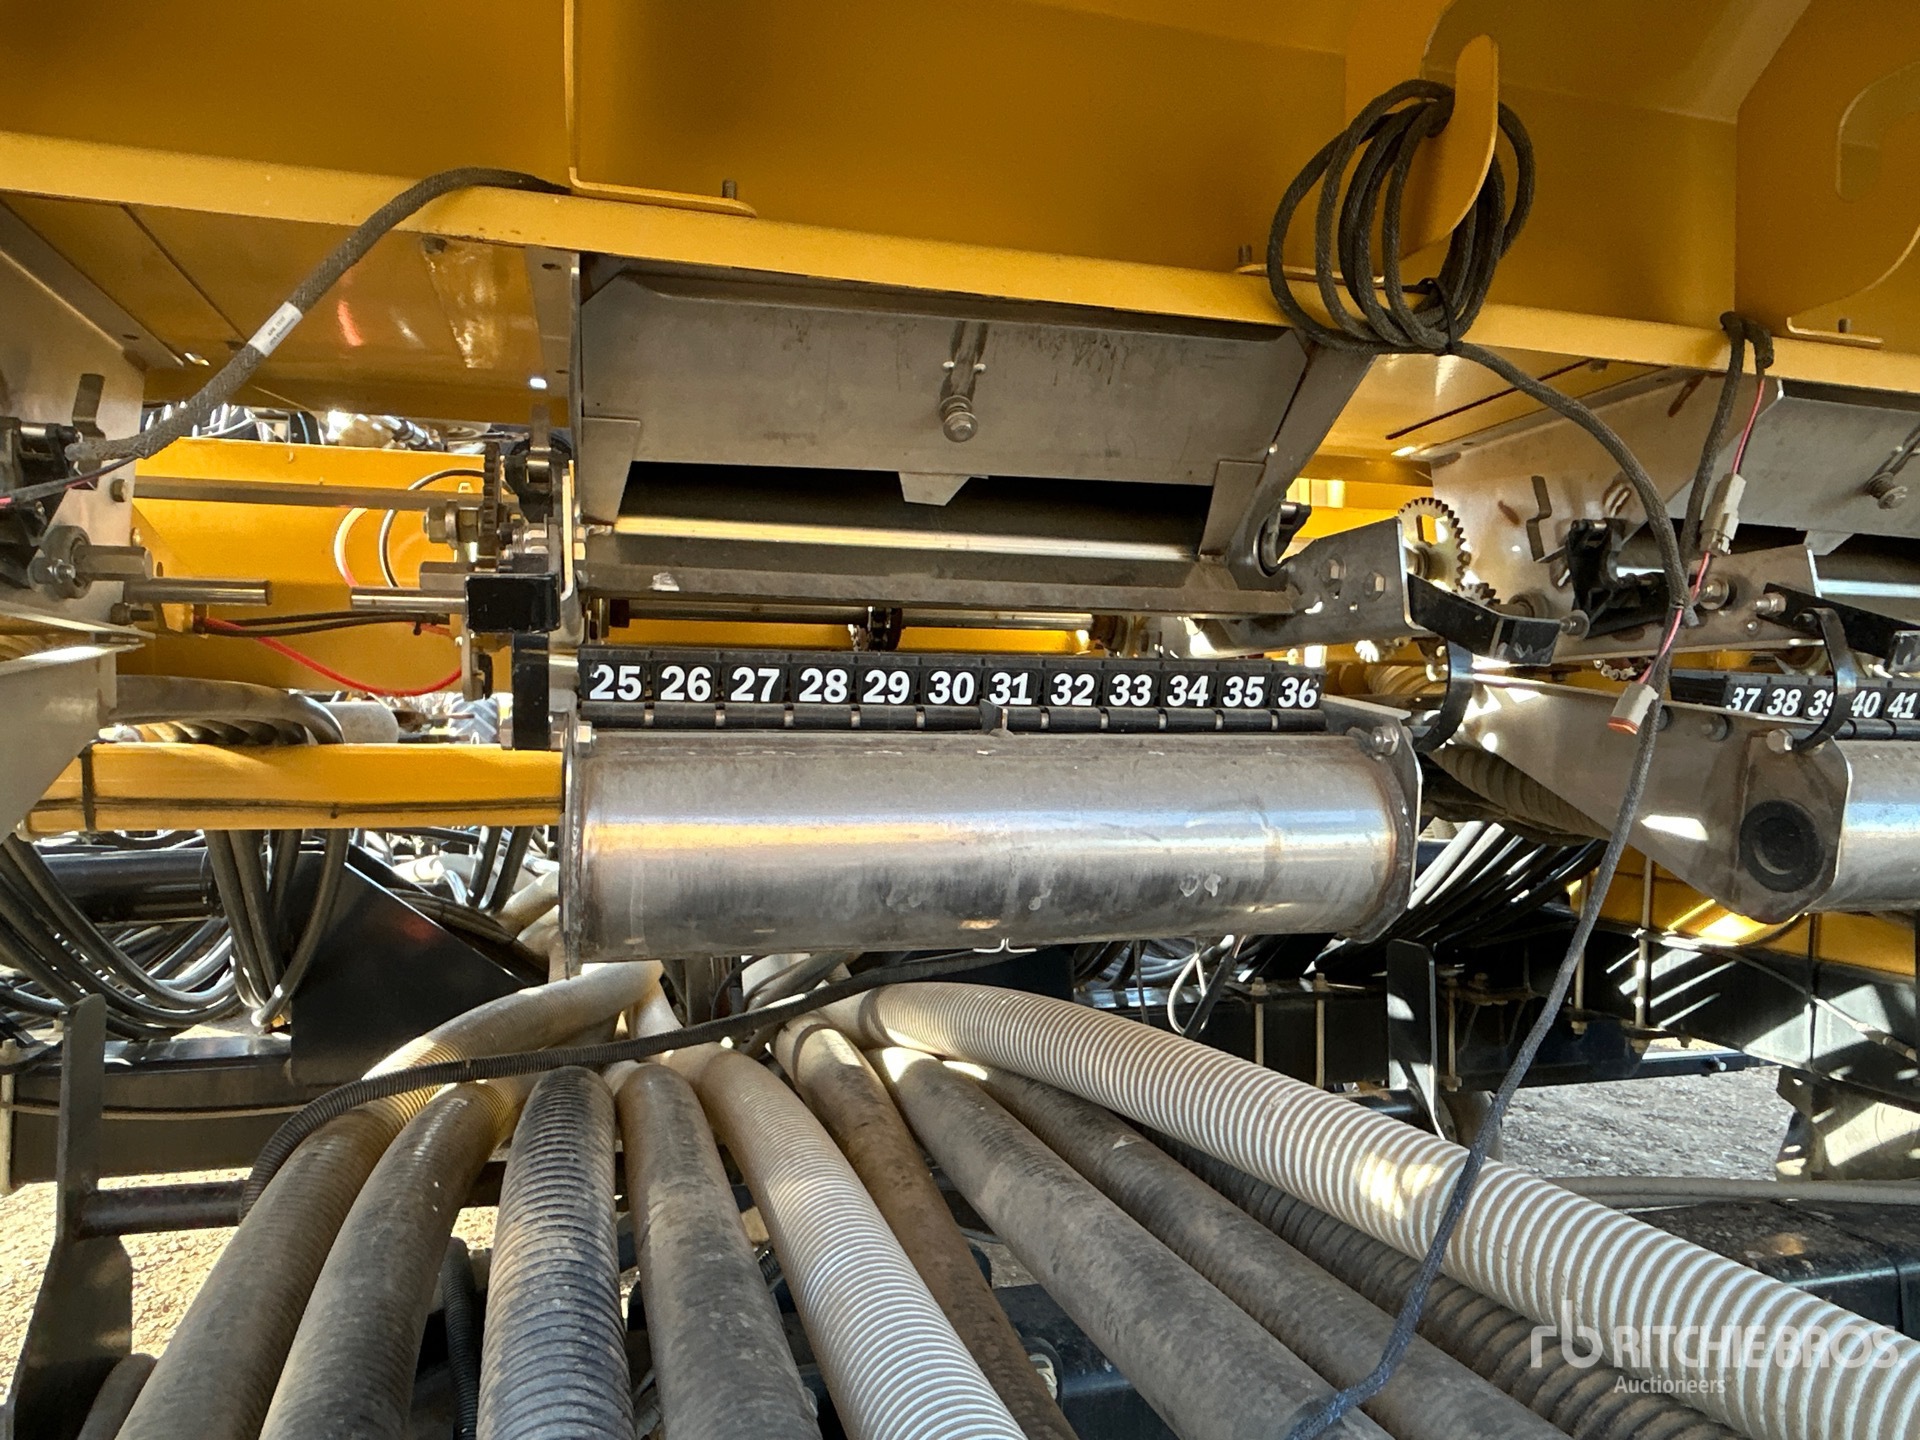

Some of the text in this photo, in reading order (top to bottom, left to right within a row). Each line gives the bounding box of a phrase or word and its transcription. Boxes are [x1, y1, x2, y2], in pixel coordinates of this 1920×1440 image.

[590, 664, 1318, 709] 25 26 27 28 29 30 31 32 33 34 35 36
[1726, 687, 1762, 712] 37
[1766, 688, 1802, 716] 38
[1851, 690, 1882, 719] 40
[1887, 692, 1918, 719] 41
